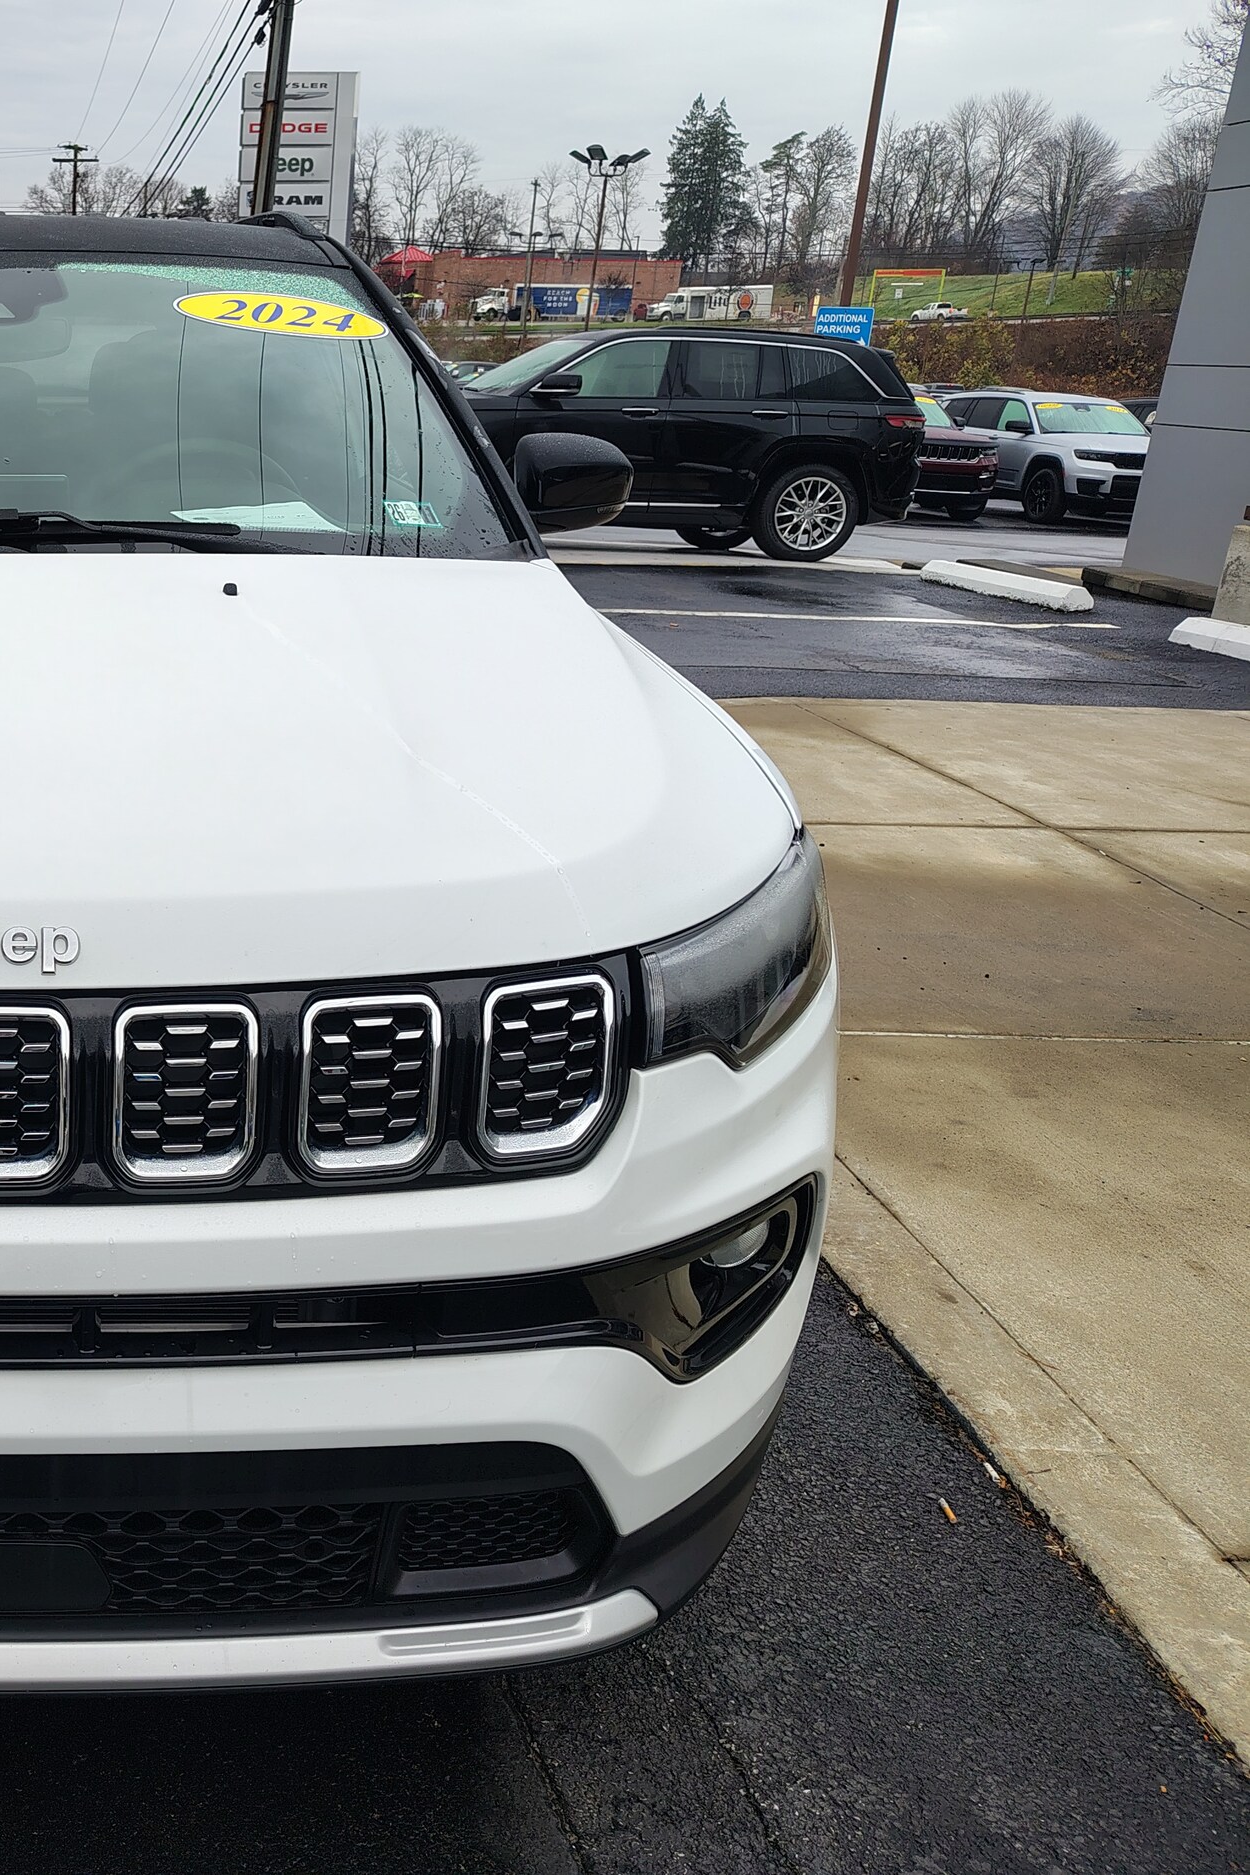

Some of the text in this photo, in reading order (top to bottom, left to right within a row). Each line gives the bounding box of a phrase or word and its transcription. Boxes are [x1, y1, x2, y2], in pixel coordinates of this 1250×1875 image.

[249, 123, 328, 133] DDGE
[275, 156, 314, 176] eep
[272, 195, 323, 205] RAM
[214, 299, 356, 332] 2024
[818, 314, 869, 323] ADDITIONAL
[816, 325, 861, 334] PARKING
[387, 503, 406, 521] 26
